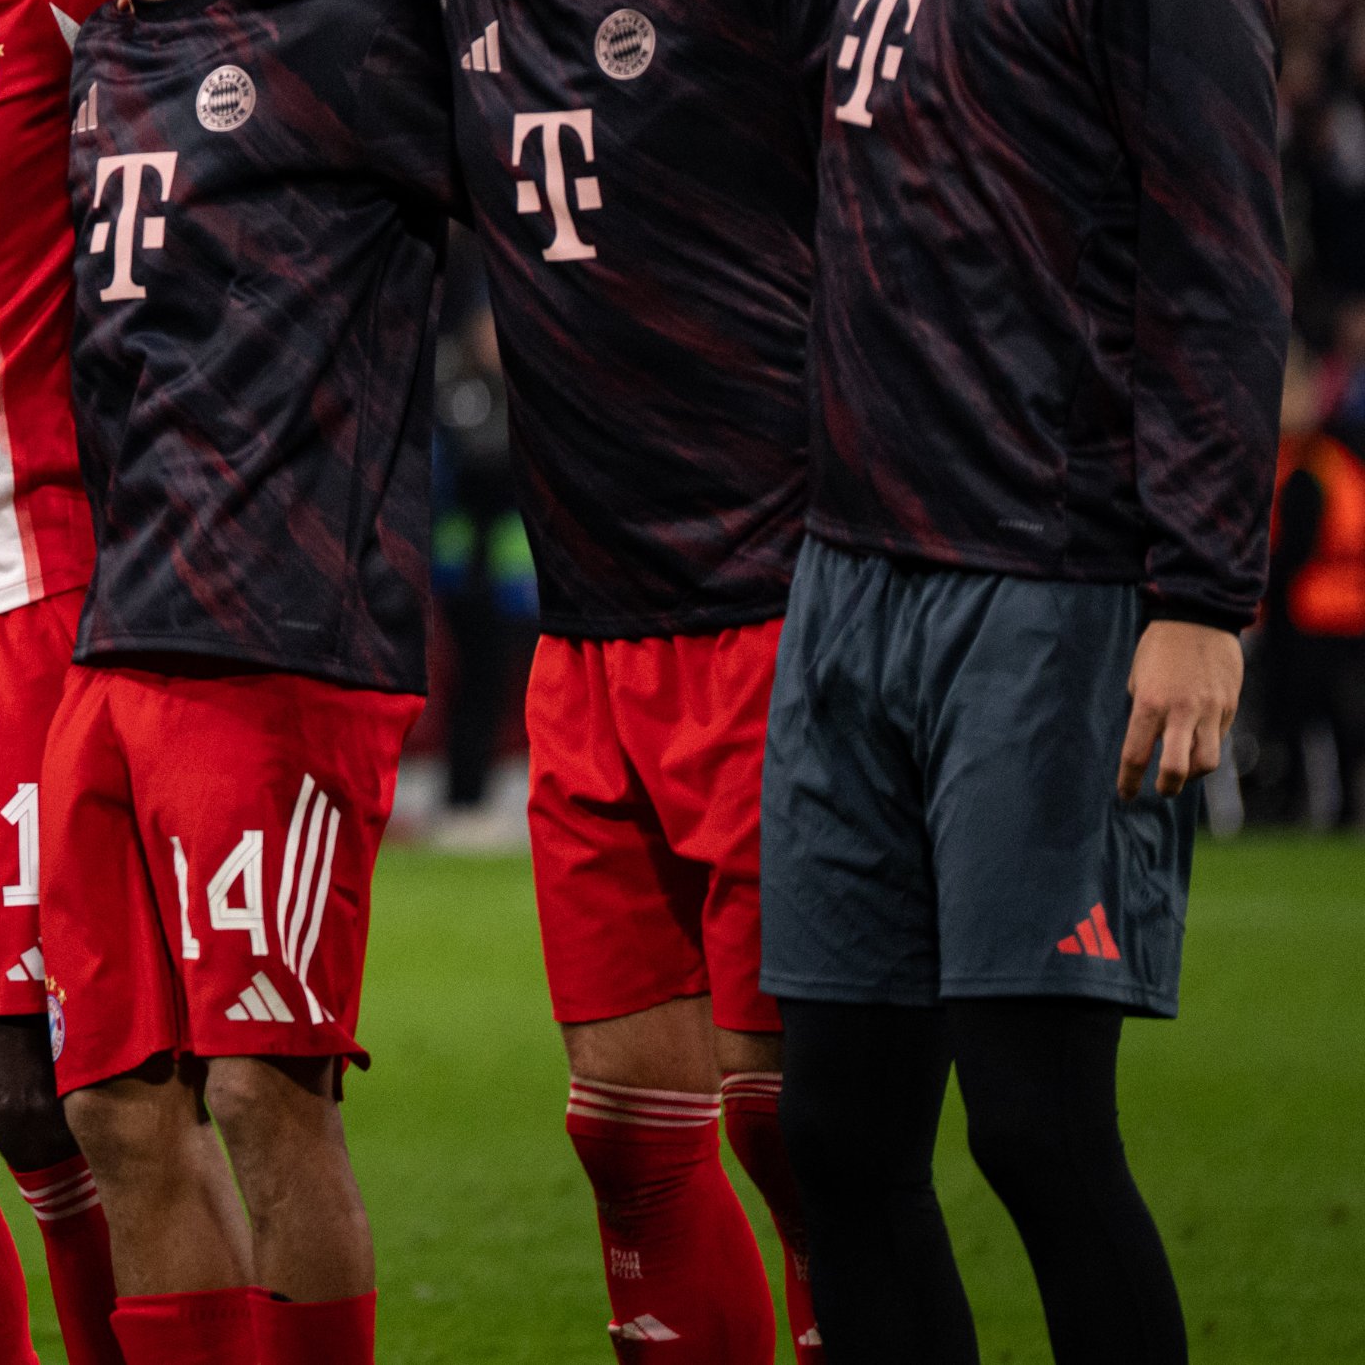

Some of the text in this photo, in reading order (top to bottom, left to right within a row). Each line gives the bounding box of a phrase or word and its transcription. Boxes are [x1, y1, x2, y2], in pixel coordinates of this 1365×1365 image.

[89, 151, 178, 302] T
[512, 109, 602, 262] T
[169, 829, 269, 960] 14
